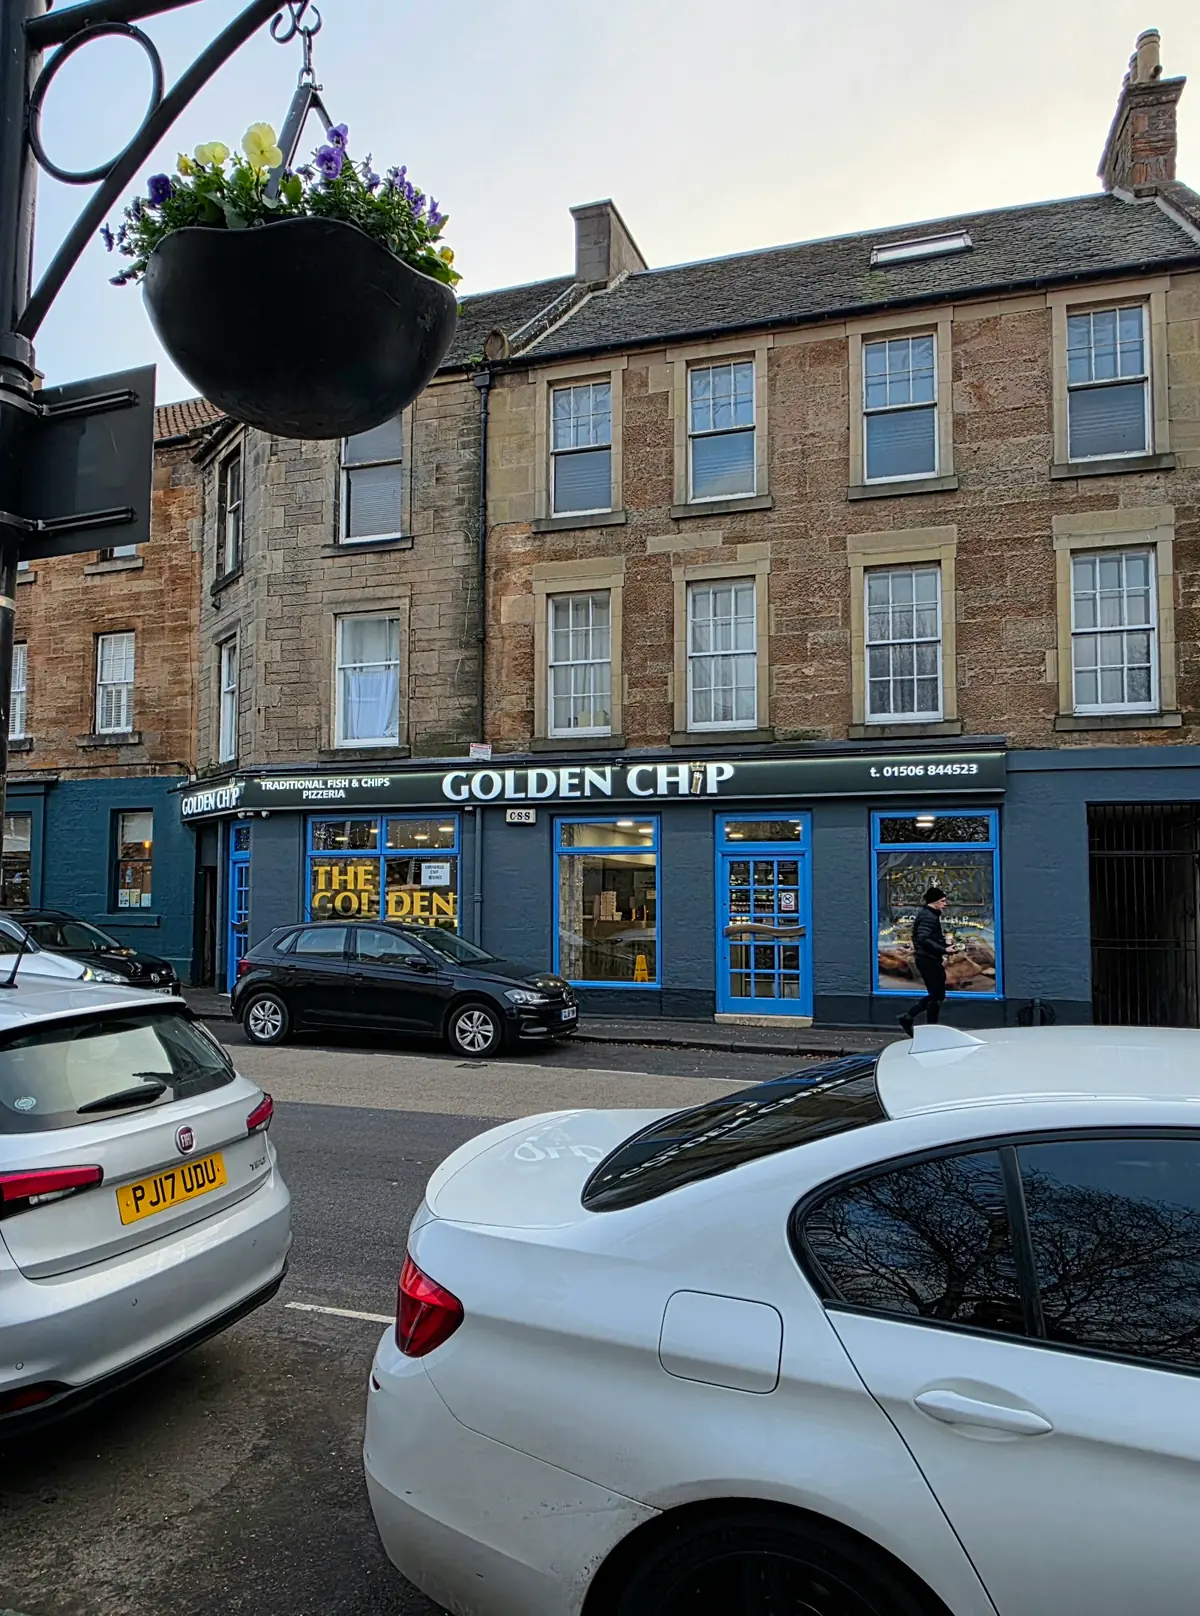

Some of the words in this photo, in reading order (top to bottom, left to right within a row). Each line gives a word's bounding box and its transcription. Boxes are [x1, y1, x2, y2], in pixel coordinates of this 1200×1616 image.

[882, 765, 925, 777] 01506
[927, 763, 979, 775] 844523
[260, 779, 325, 790] TRADITIONAL
[327, 778, 349, 789] FISH
[351, 778, 359, 787] &
[360, 777, 391, 788] CHIPS
[302, 789, 346, 800] PIZZERIA
[441, 766, 612, 801] GOLDEN
[181, 791, 216, 816] GOLDEN
[312, 866, 374, 890] THE
[312, 891, 454, 916] GOLDEN
[131, 1173, 176, 1214] PJ17
[181, 1159, 217, 1194] UDU
